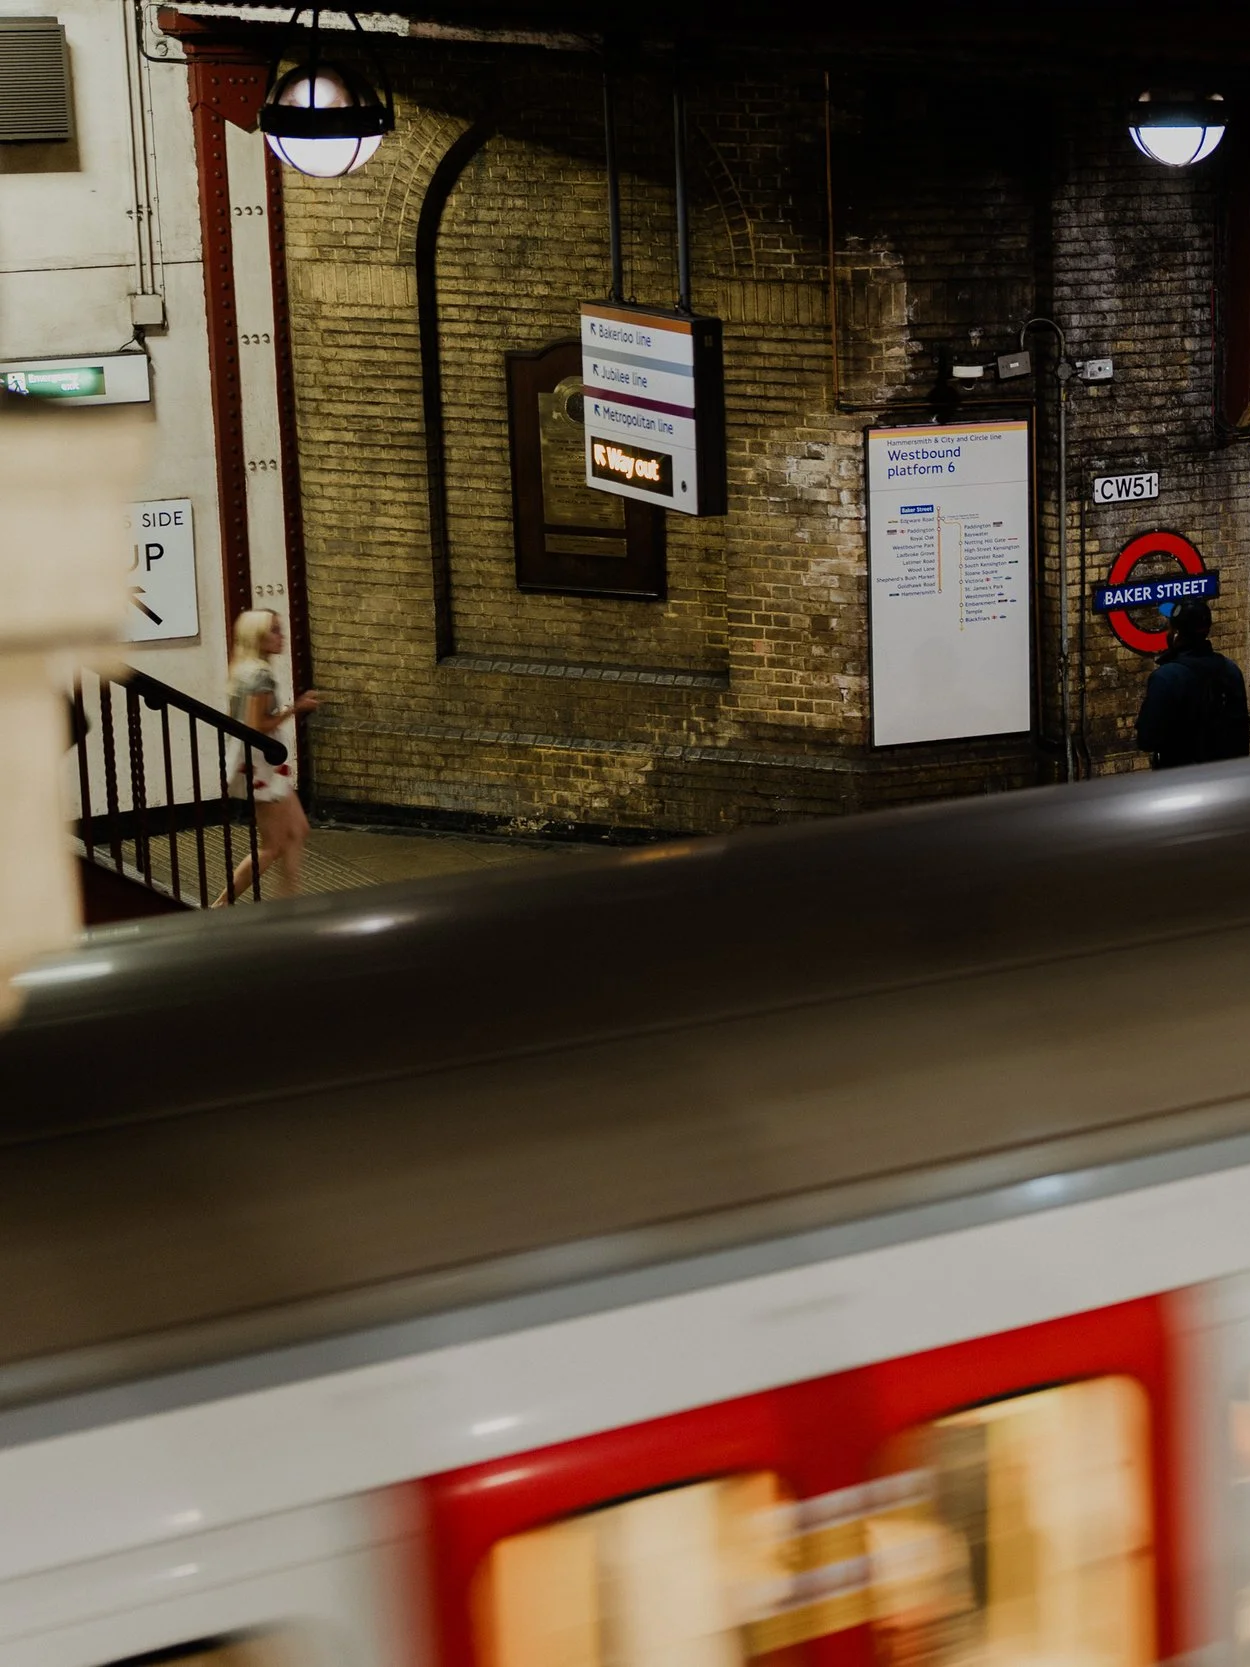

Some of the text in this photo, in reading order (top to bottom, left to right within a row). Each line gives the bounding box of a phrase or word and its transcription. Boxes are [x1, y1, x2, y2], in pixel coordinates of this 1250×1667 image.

[599, 324, 652, 347] Bakerloo line
[601, 365, 648, 388] Jubilee line
[603, 406, 674, 435] Metropolitan line
[887, 438, 933, 446] Hammersmith
[941, 436, 954, 444] City
[969, 434, 989, 442] Circle
[606, 446, 660, 481] Way out
[888, 446, 961, 461] Westbound
[888, 461, 956, 479] platform 6
[1101, 476, 1153, 500] CW51
[142, 511, 184, 528] SIDE
[1104, 579, 1208, 605] BAKER STREET
